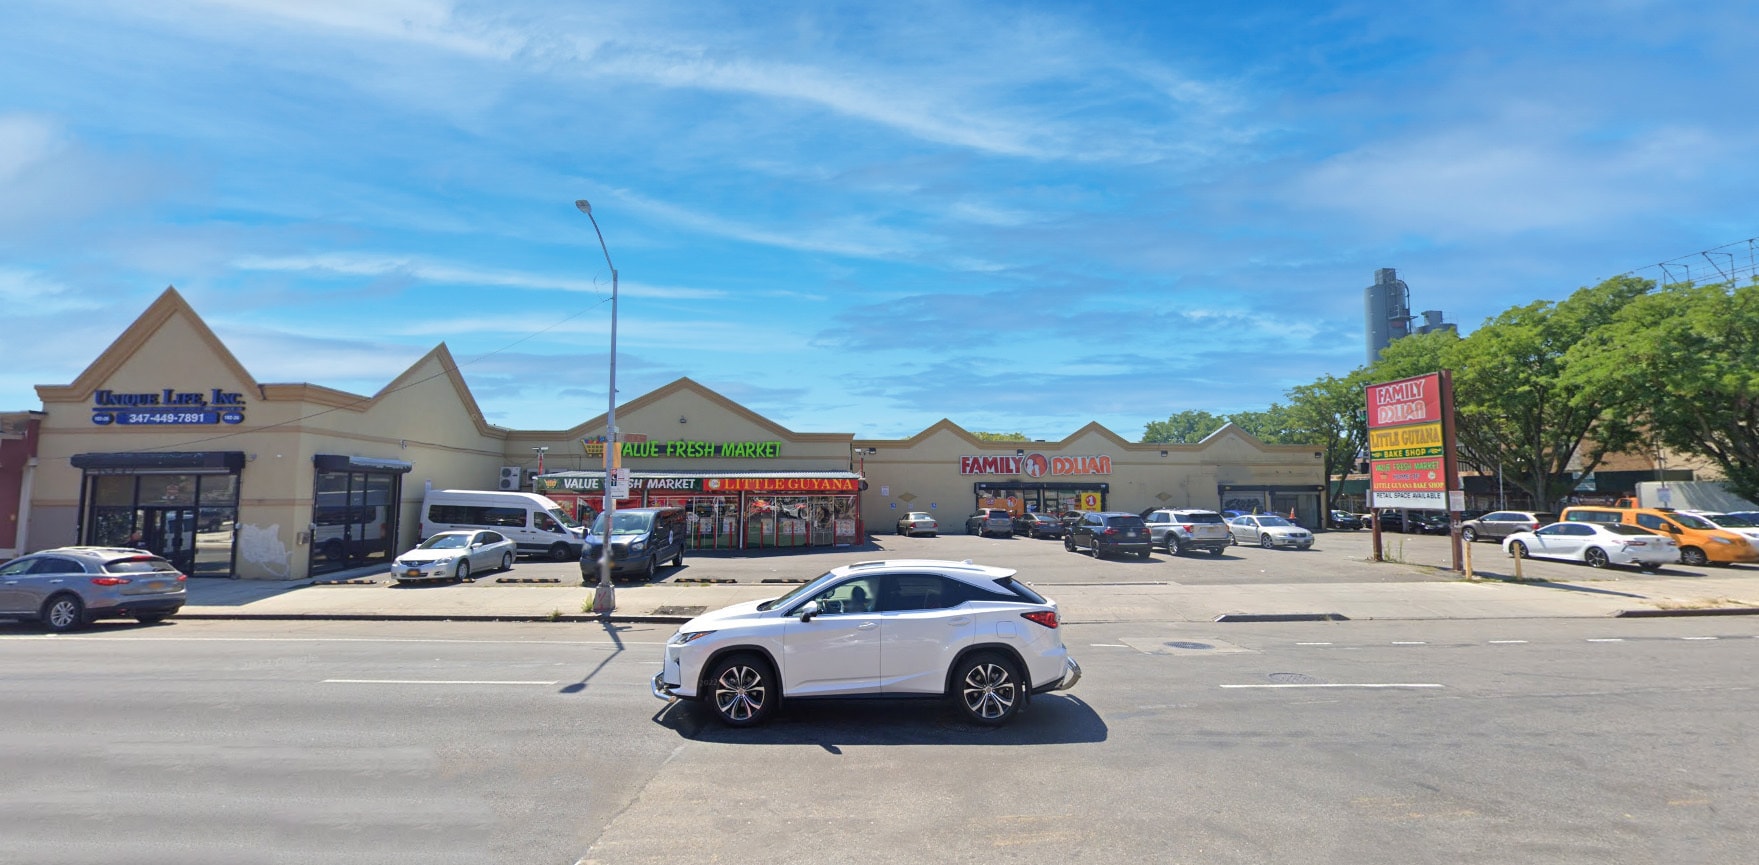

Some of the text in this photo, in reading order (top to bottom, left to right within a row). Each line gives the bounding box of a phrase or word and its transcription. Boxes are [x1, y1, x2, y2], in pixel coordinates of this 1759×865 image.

[1376, 379, 1426, 405] FAMILY
[129, 413, 204, 423] 347-449-7891
[1377, 400, 1426, 424] DOLLAR
[1370, 427, 1440, 449] LITTLE GUYANA
[620, 440, 782, 458] ALUE FRESH MARKET
[1384, 448, 1426, 458] BAKE SHOP
[960, 454, 1113, 475] FAMILY DOLLAR
[564, 478, 599, 489] VALUE
[647, 478, 695, 489] MARKET
[724, 479, 853, 489] LITTLE GUYANA
[1373, 482, 1391, 490] LITTLE
[1428, 481, 1444, 489] SHOP
